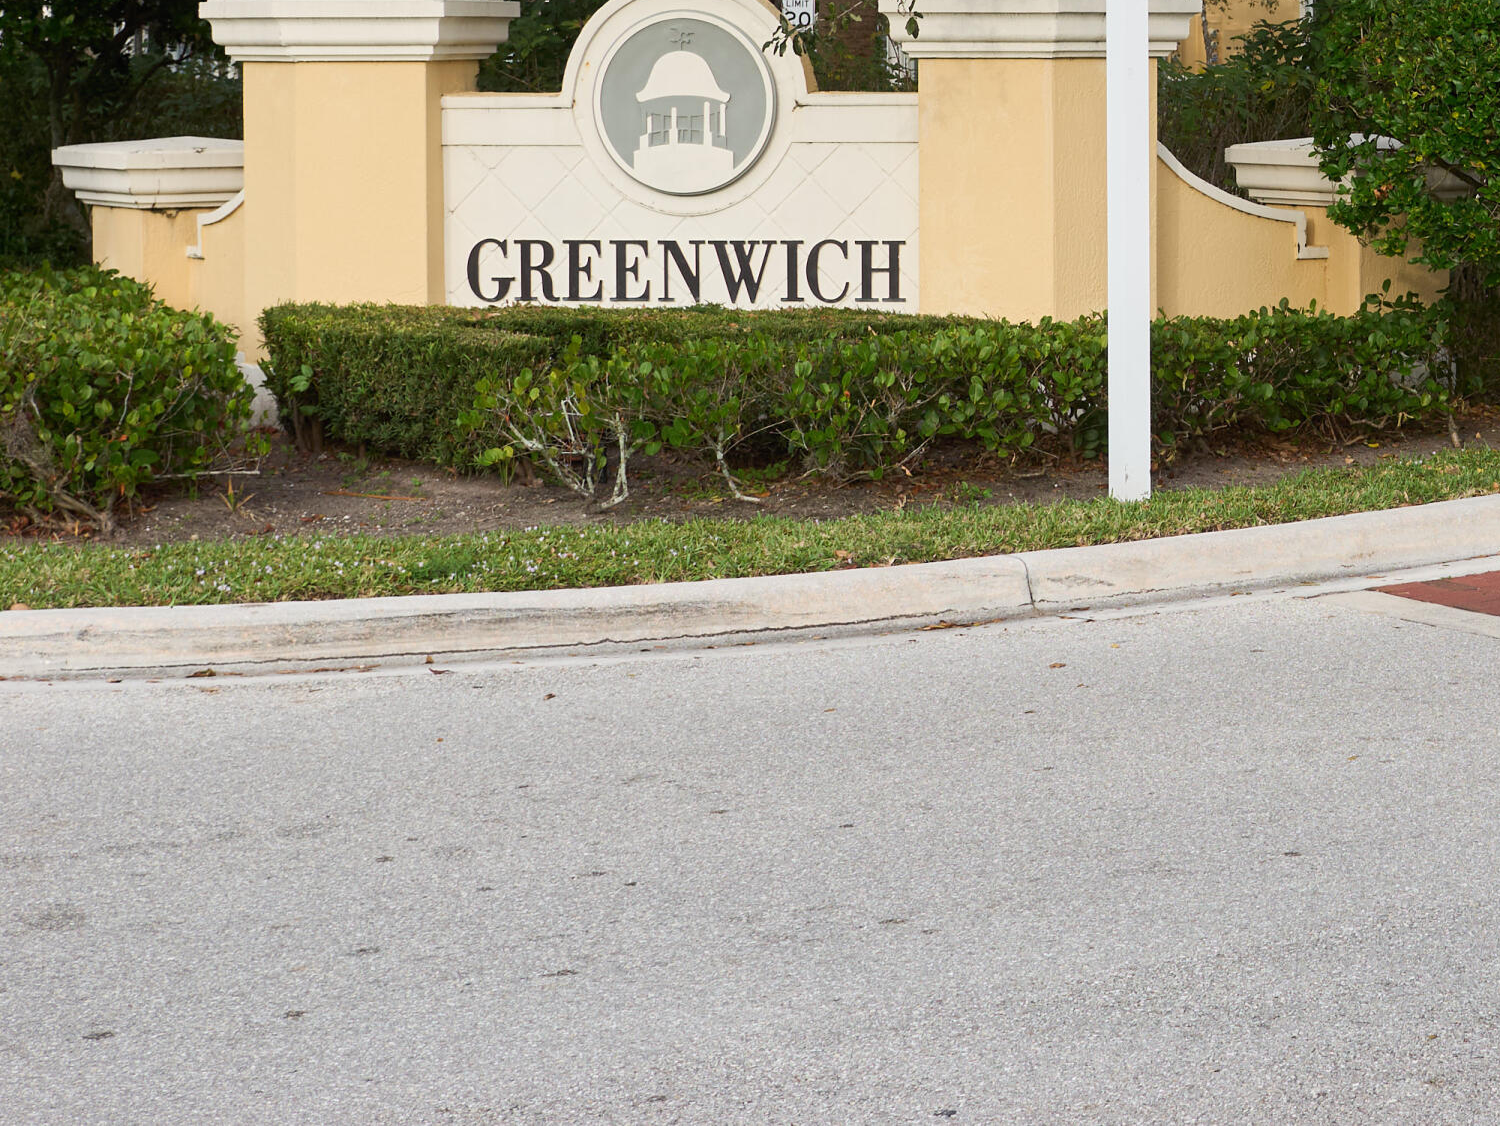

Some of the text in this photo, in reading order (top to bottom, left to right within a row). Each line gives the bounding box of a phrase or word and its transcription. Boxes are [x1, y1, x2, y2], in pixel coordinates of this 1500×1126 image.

[786, 0, 809, 8] LIMIT
[784, 11, 811, 27] 20
[466, 237, 907, 304] GREENWICH
